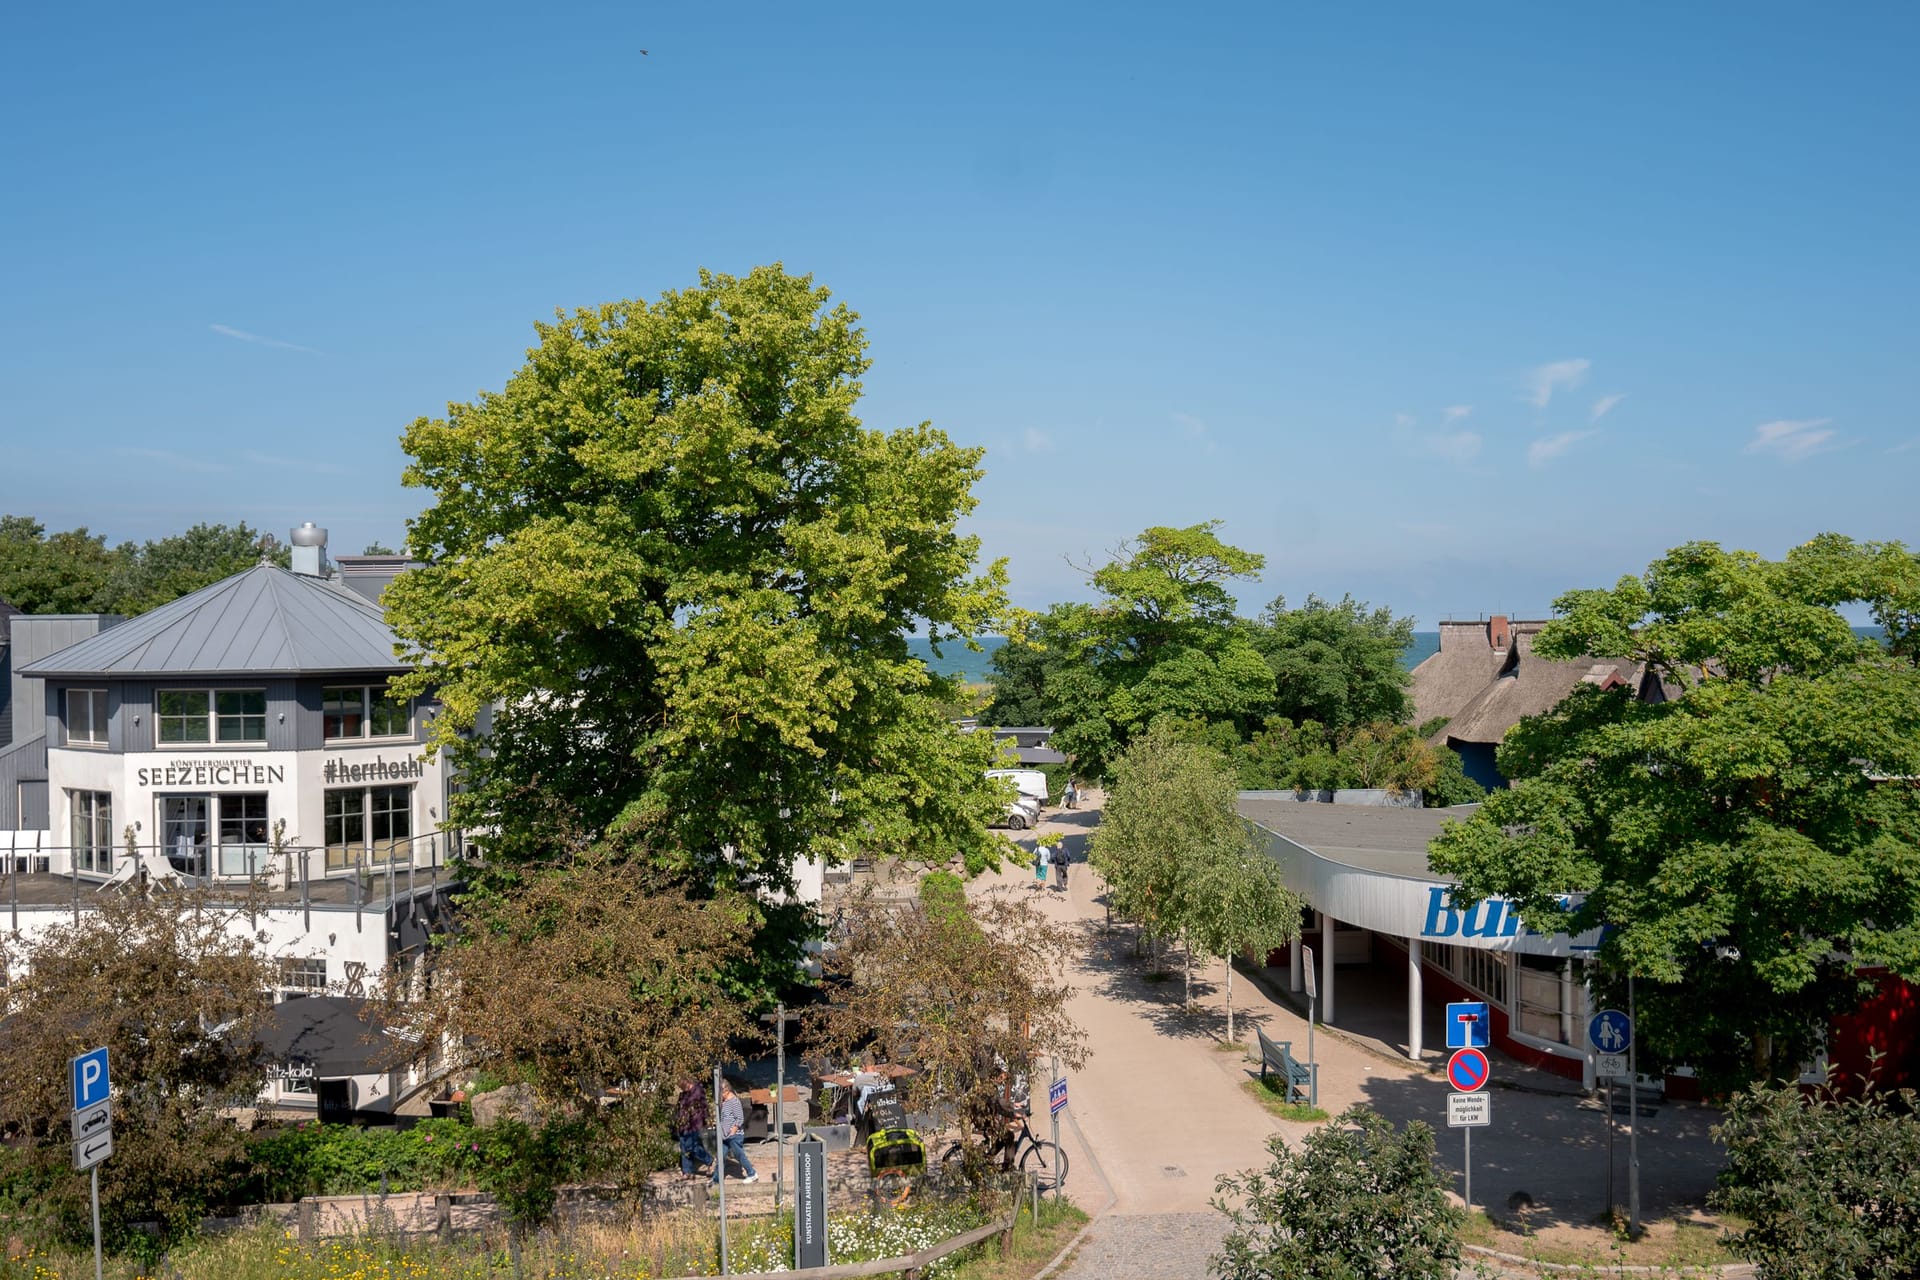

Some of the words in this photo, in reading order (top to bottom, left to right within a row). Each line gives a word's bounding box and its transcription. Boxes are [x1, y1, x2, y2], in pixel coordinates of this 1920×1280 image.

[138, 765, 284, 786] SEEZEICHEN
[324, 753, 423, 784] #herrhoshi
[82, 1059, 101, 1101] P
